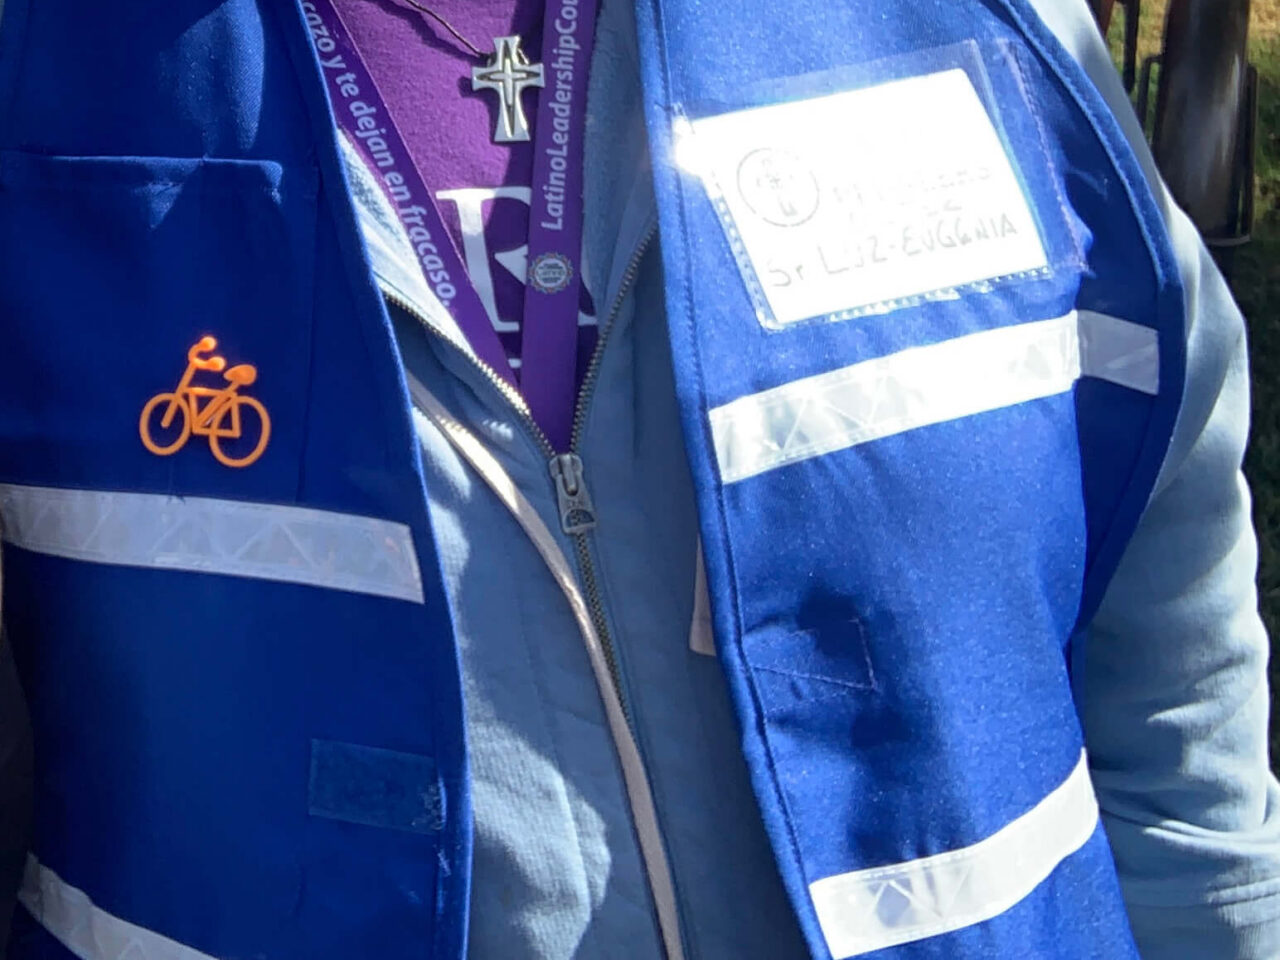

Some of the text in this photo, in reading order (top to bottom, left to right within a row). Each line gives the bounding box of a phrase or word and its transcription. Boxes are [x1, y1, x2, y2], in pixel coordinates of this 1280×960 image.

[321, 54, 347, 70] y
[335, 72, 360, 98] te
[349, 100, 396, 168] dejan
[384, 170, 412, 205] en
[399, 204, 457, 308] fracaso.
